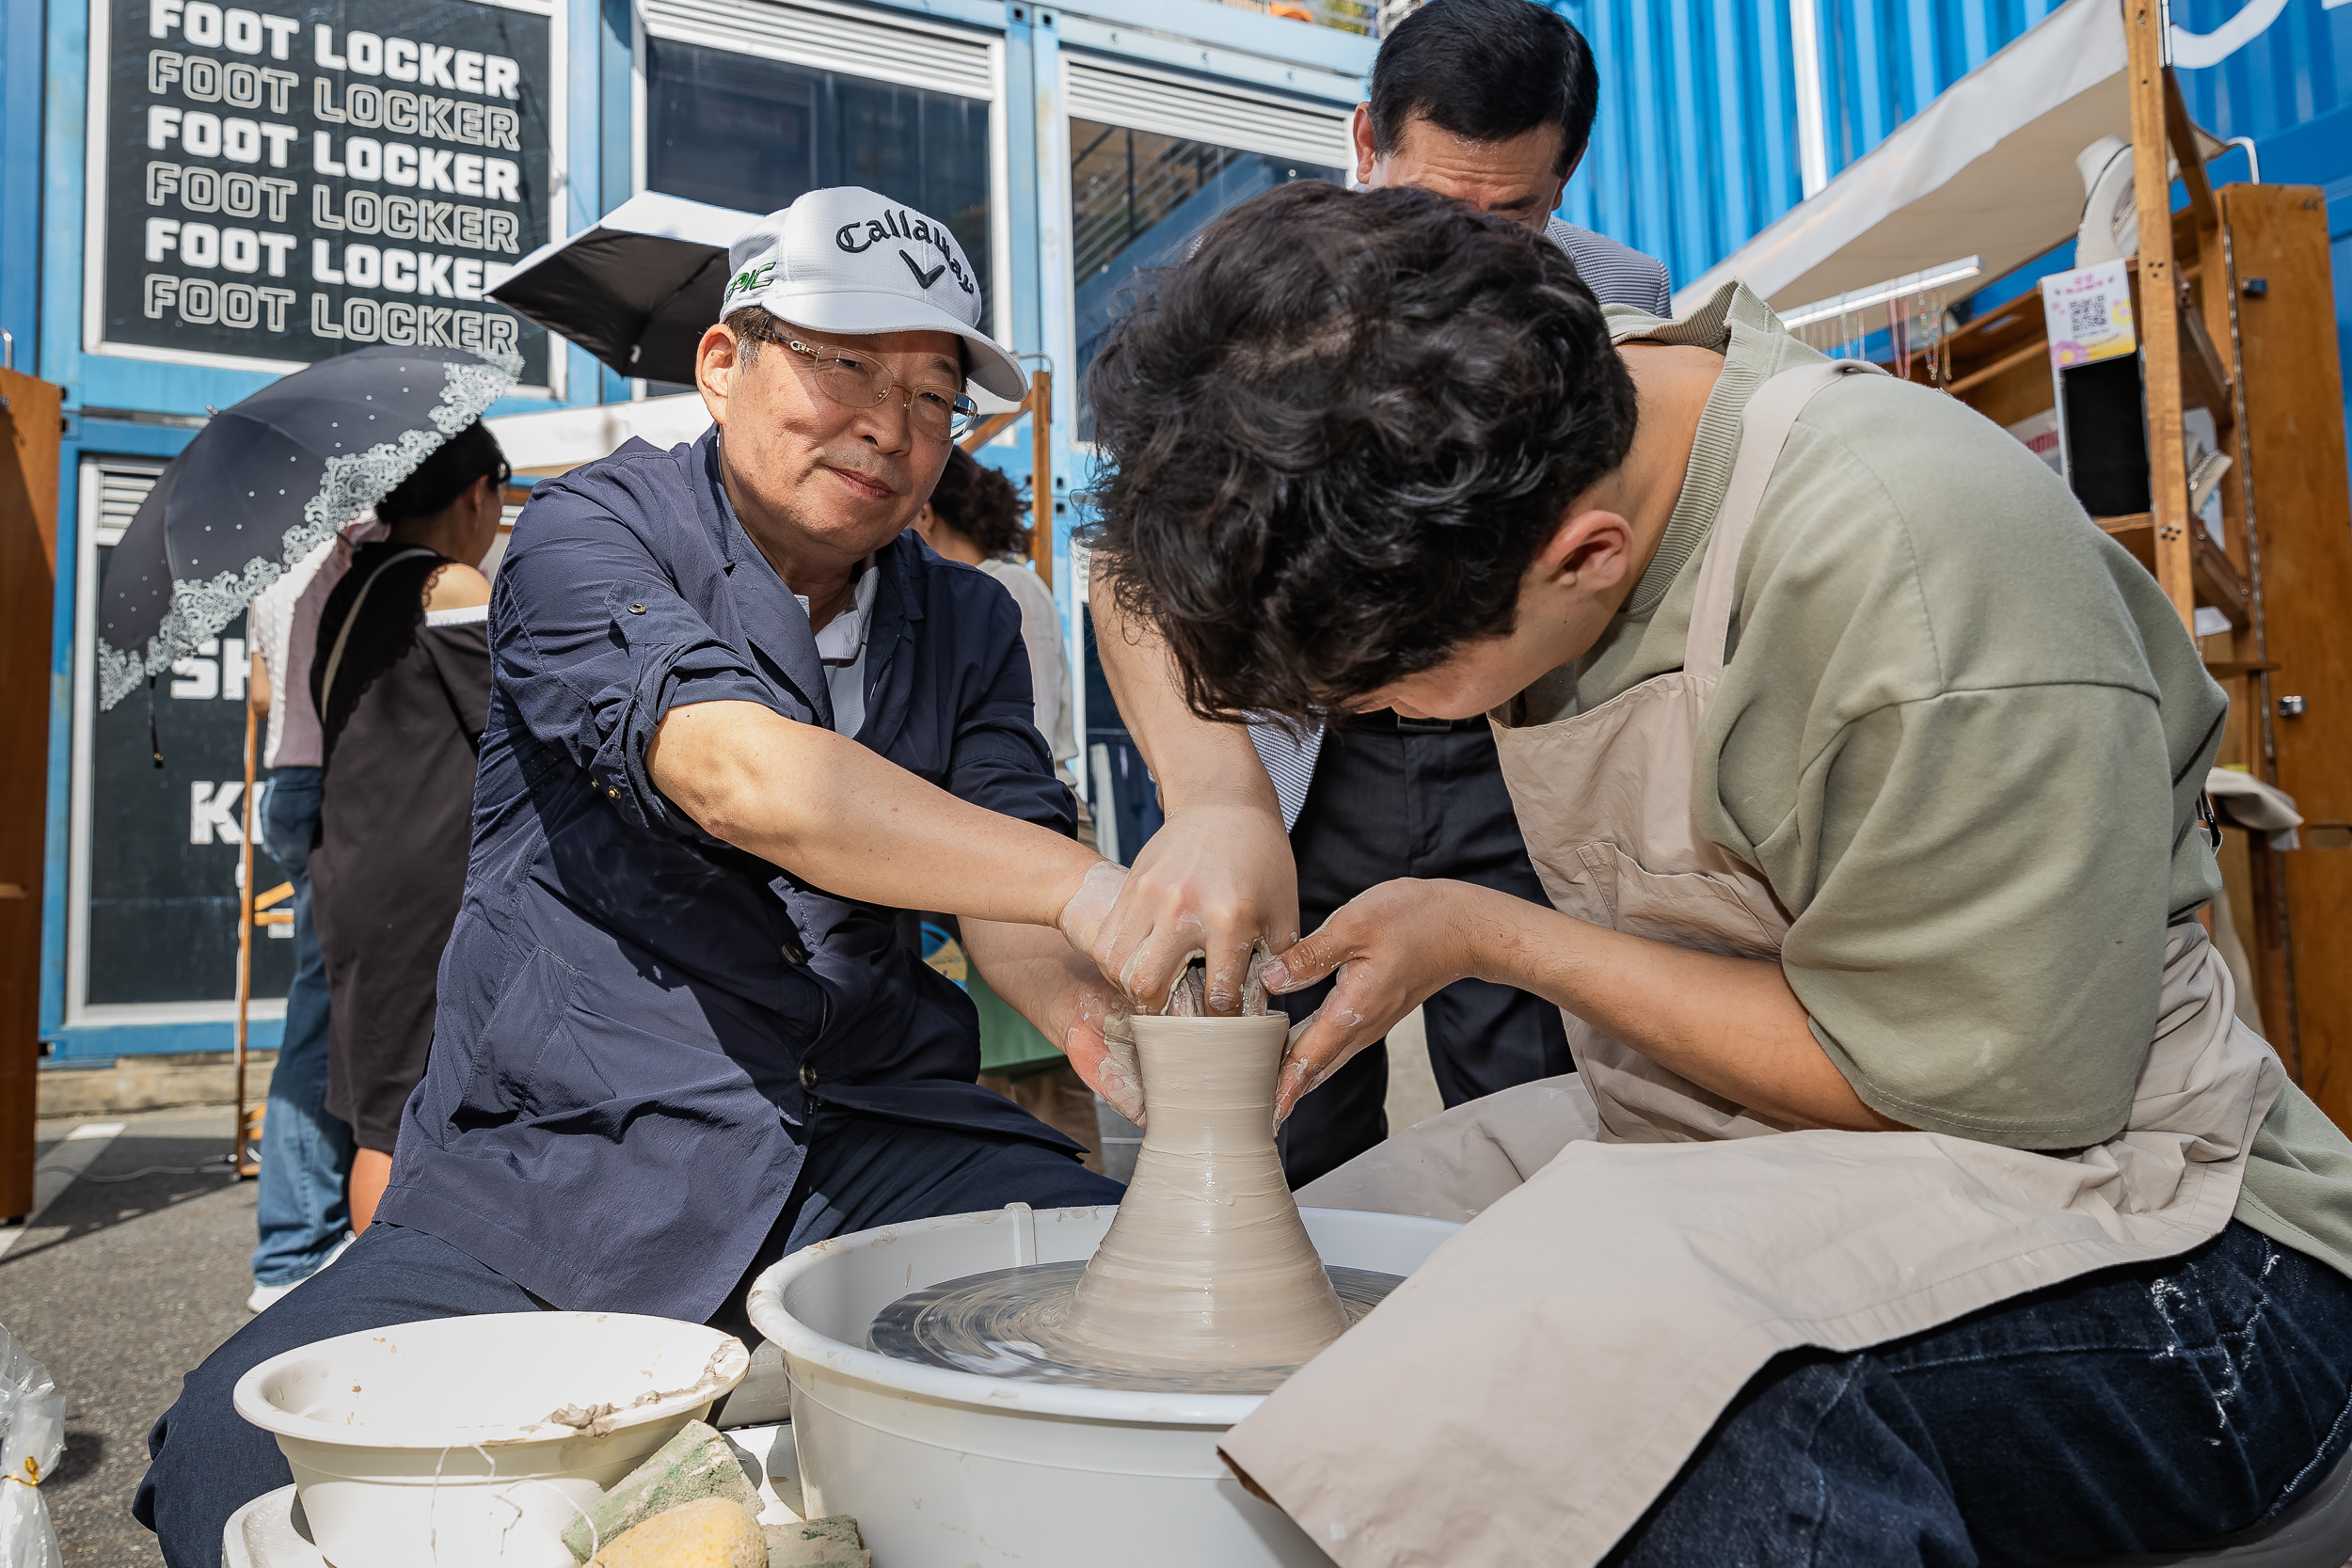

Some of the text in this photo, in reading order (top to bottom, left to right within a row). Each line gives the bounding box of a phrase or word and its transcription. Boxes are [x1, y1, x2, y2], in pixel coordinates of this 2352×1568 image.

[149, 0, 521, 102] FOOT LOCKER
[148, 49, 521, 152] FOOT LOCKER
[147, 104, 521, 203] FOOT LOCKER
[145, 216, 297, 277] FOOT
[146, 160, 521, 255] FOOT LOCKER
[835, 209, 975, 294] Callaway
[144, 273, 520, 356] FOOT LOCKER
